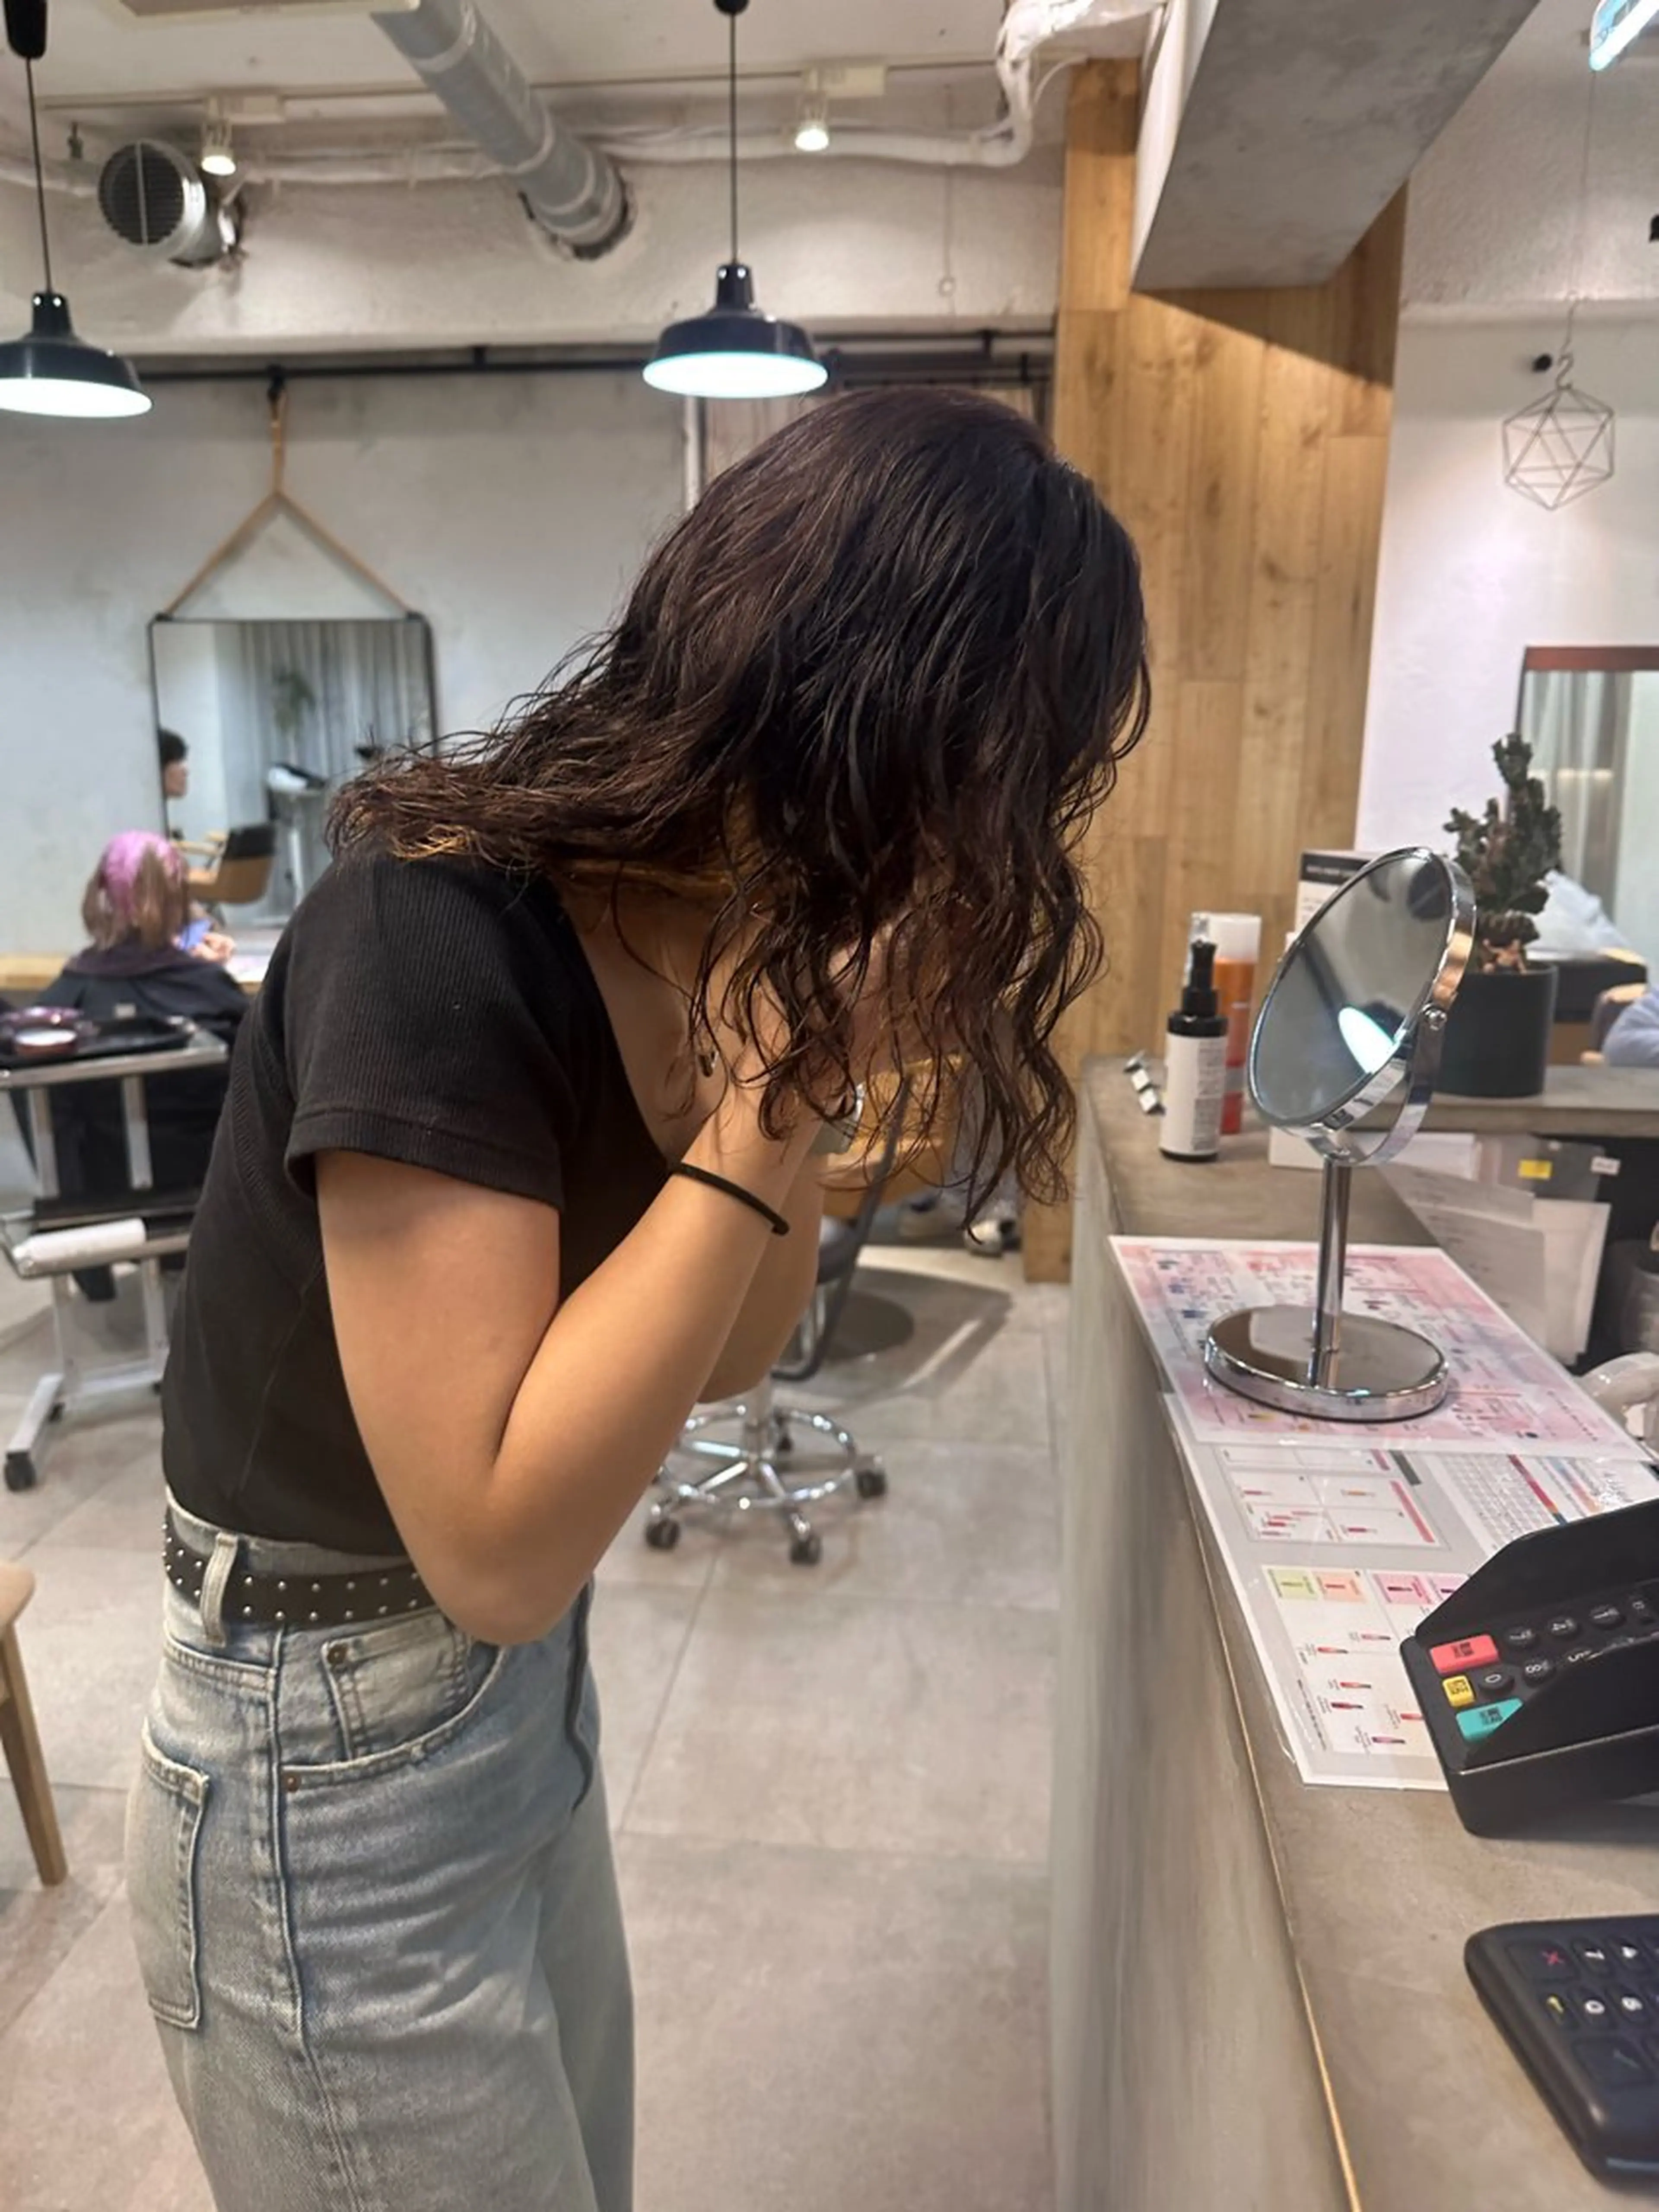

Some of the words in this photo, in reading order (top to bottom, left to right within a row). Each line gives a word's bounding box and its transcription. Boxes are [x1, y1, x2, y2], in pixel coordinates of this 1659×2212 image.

[1525, 1663, 1543, 1674] 8
[1484, 1673, 1502, 1683] 0
[1584, 1999, 1605, 2015] 0
